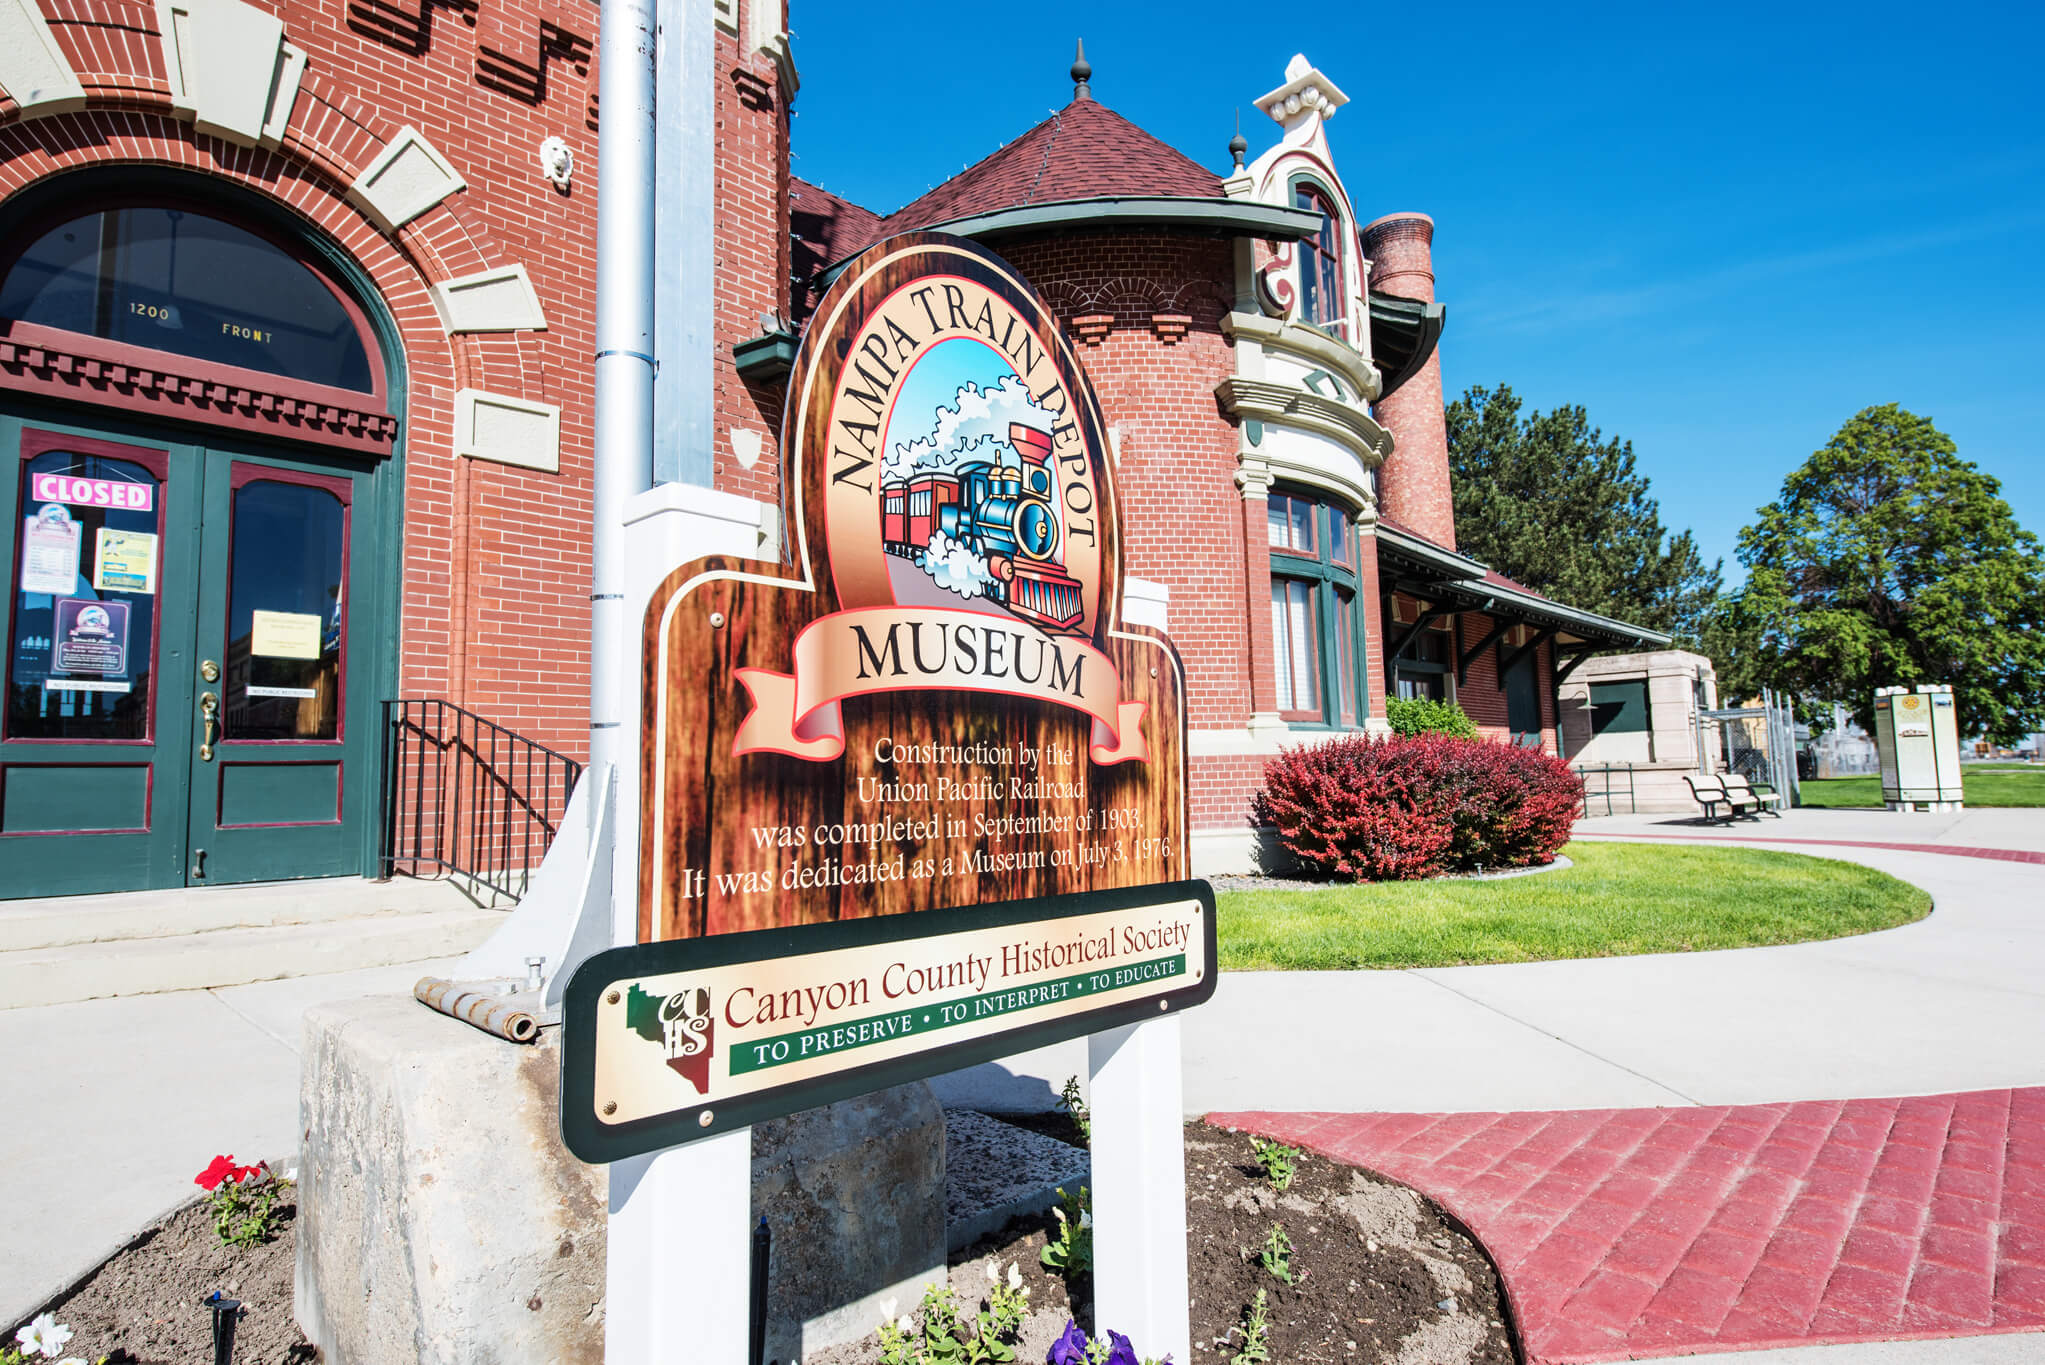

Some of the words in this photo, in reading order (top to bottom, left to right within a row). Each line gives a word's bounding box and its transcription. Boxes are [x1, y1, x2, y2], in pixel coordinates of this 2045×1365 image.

[130, 302, 170, 321] 1200
[222, 323, 273, 344] FRONT
[833, 315, 920, 495] NAMPA
[910, 283, 1046, 378] TRAIN
[1033, 379, 1097, 549] DEPOT
[39, 476, 146, 507] CLOSED
[850, 622, 1088, 699] MUSEUM
[874, 737, 1013, 765] Construction
[1018, 741, 1041, 771] by
[1046, 742, 1073, 766] the
[856, 776, 930, 802] Union
[936, 775, 1005, 801] Pacific
[1009, 776, 1085, 800] Railroad
[752, 824, 806, 849] was
[814, 813, 941, 850] completed
[946, 813, 968, 839] in
[973, 810, 1072, 842] September
[1075, 808, 1093, 831] of
[1100, 807, 1144, 831] 1903.
[682, 868, 706, 899] It
[715, 869, 773, 897] was
[781, 853, 905, 890] dedicated
[911, 858, 936, 879] as
[941, 857, 954, 877] a
[960, 849, 1047, 875] Museum
[1050, 845, 1073, 867] on
[1075, 840, 1110, 871] July
[1113, 839, 1128, 866] 3,
[1134, 837, 1175, 860] 1976.
[724, 976, 871, 1029] Canyon
[882, 953, 992, 999] County
[1000, 927, 1117, 978] Historical
[1123, 919, 1191, 956] Society
[753, 1040, 790, 1065] TO
[800, 1014, 913, 1056] PRESERVE
[940, 1003, 968, 1024] TO
[974, 981, 1071, 1017] INTERPRET
[1089, 973, 1111, 991] TO
[1115, 960, 1177, 985] EDUCATE
